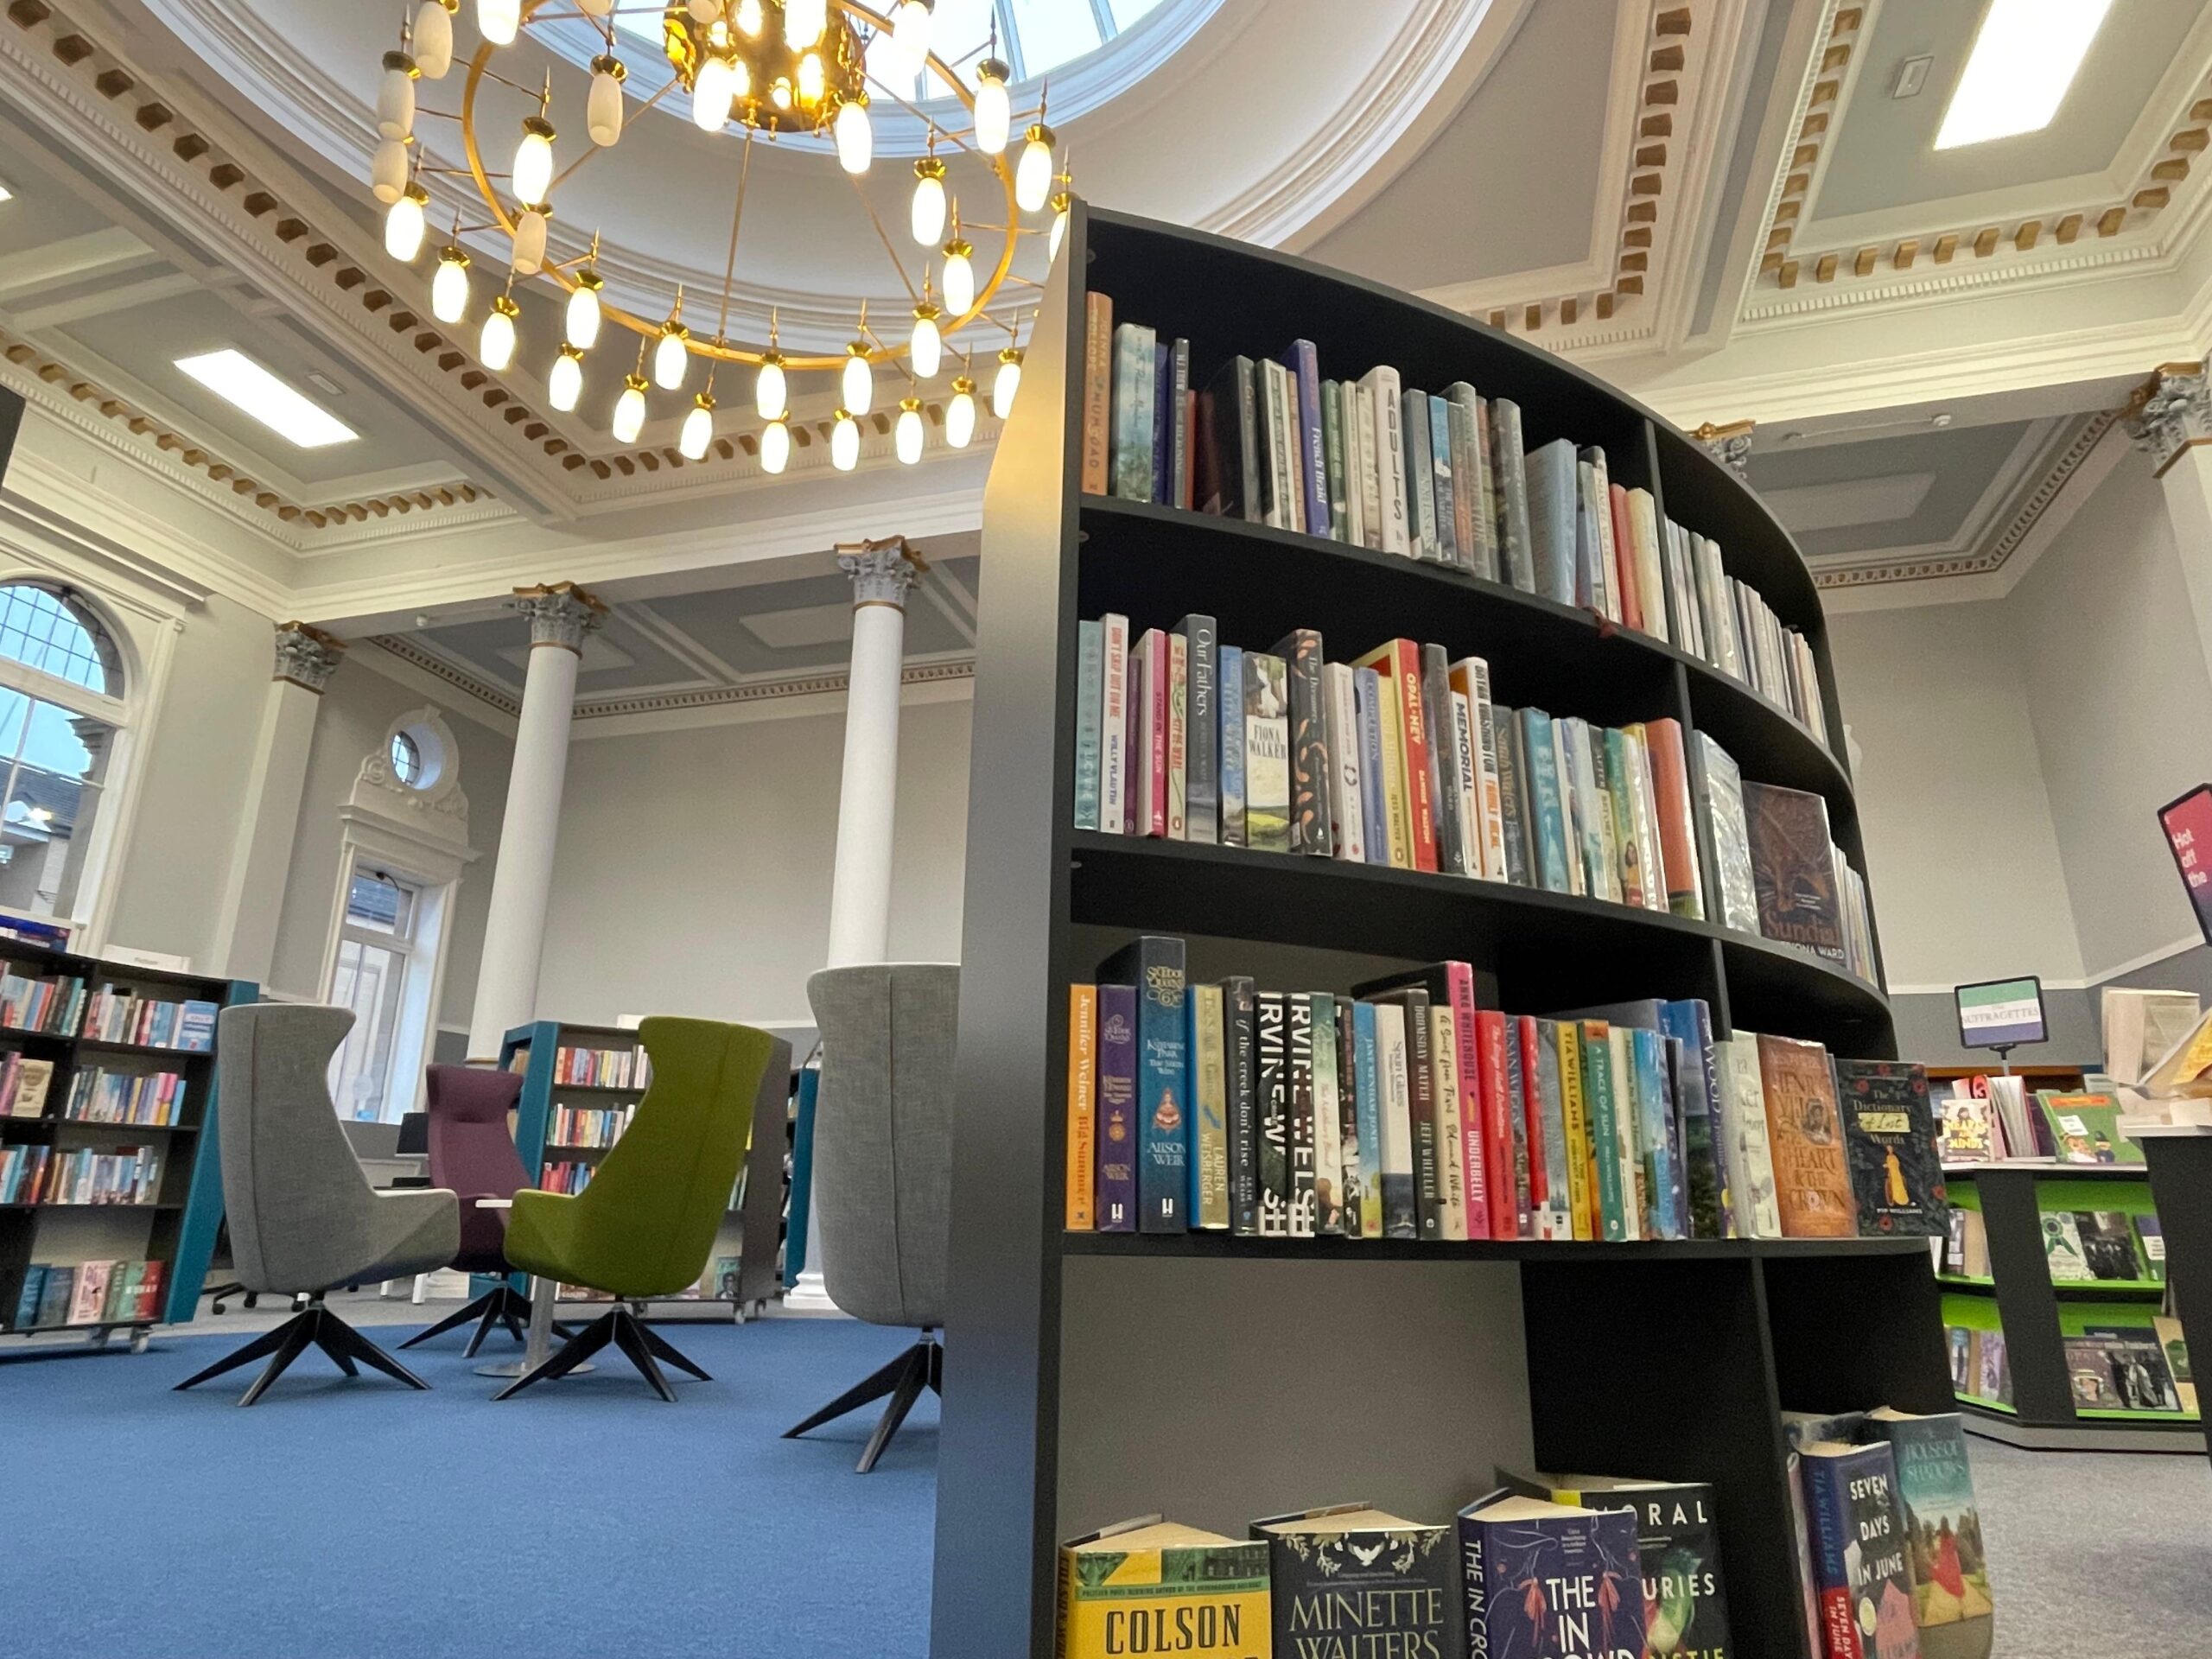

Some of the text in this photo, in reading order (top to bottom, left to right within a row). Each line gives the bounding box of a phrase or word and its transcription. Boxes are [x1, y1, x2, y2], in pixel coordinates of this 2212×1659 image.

[1087, 308, 1098, 372] TROLLOPE
[1099, 317, 1109, 368] JOANNA
[1090, 392, 1102, 468] MUM DAD
[1311, 427, 1326, 504] French Braid
[1388, 388, 1402, 520] ADULTS
[1109, 626, 1122, 719] DON'T SKIP OUT ON ME
[1196, 628, 1212, 716] Our Fathers
[1309, 657, 1319, 724] The Dreamers
[1406, 673, 1417, 708] OPAL
[1155, 721, 1162, 732] IN
[1253, 724, 1281, 744] FIONA
[1409, 715, 1421, 745] NEV
[1474, 664, 1496, 774] BRYAN WASHINGTON
[1249, 739, 1287, 760] WALKER
[1455, 702, 1473, 792] MEMORIAL
[1496, 726, 1516, 817] Sarah Waters
[1595, 753, 1606, 789] AFTER
[1390, 794, 1402, 842] JESS WALTER
[1421, 808, 1430, 844] WALTON
[1485, 779, 1501, 849] FAMILY MEAL
[2172, 829, 2195, 849] Hot
[2182, 849, 2196, 868] off
[2188, 871, 2207, 888] the
[1765, 911, 1841, 942] Sundial
[1818, 946, 1845, 959] WARD
[1160, 992, 1172, 1003] 6
[1961, 1007, 2039, 1025] SUFFRAGETTES
[1441, 1028, 1451, 1055] Saint
[1459, 978, 1476, 1081] ANNA WHITEHOUSE
[1077, 995, 1091, 1110] Jennifer Weiner
[1390, 1040, 1405, 1071] Spun
[1414, 1006, 1429, 1101] DOOMSDAY MATCH
[1438, 1058, 1453, 1082] from
[1625, 1039, 1634, 1084] Nothing
[1395, 1074, 1406, 1107] Glass
[1506, 1021, 1522, 1125] SUSAN WIGGS
[1564, 1032, 1580, 1131] TIA WILLIAMS
[1596, 1058, 1606, 1092] TRACE
[1704, 1043, 1721, 1114] WOOD
[1236, 1019, 1251, 1167] if the creek don't rise
[1365, 1037, 1378, 1149] JANE WENHAM-JONES
[1443, 1084, 1455, 1115] Texas
[1599, 1096, 1607, 1109] OF
[1853, 1100, 1912, 1113] Dictionary
[1873, 1090, 1889, 1100] The
[1291, 994, 1315, 1237] IRVINE WELSH
[1601, 1113, 1610, 1137] SUN
[1878, 1113, 1904, 1129] Lost
[1147, 1141, 1185, 1154] ALISON
[1870, 1134, 1905, 1146] Words
[1077, 1116, 1089, 1205] Big Summer
[1154, 1154, 1185, 1166] WEIR
[1201, 1133, 1214, 1205] WEISBERGER
[1214, 1147, 1225, 1192] LAUREN
[1420, 1121, 1435, 1199] JEFF WHEELER
[1446, 1124, 1460, 1210] Edmund White
[1467, 1130, 1484, 1203] UNDERBELLY
[1787, 1147, 1839, 1175] HEART
[1850, 1474, 1889, 1501] SEVEN
[1812, 1470, 1839, 1574] TIA WILLIAMS
[1859, 1515, 1891, 1541] DAYS
[1465, 1540, 1486, 1613] THE IN
[1642, 1573, 1716, 1600] URIES
[1858, 1552, 1904, 1586] IN JUNE
[1287, 1587, 1445, 1632] MINETTE
[1545, 1575, 1597, 1611] THE
[1106, 1604, 1242, 1656] COLSON
[1558, 1611, 1590, 1654] IN
[1829, 1606, 1842, 1653] IN JUNE
[1836, 1596, 1849, 1633] SEVEN
[1295, 1630, 1444, 1659] WALTERS
